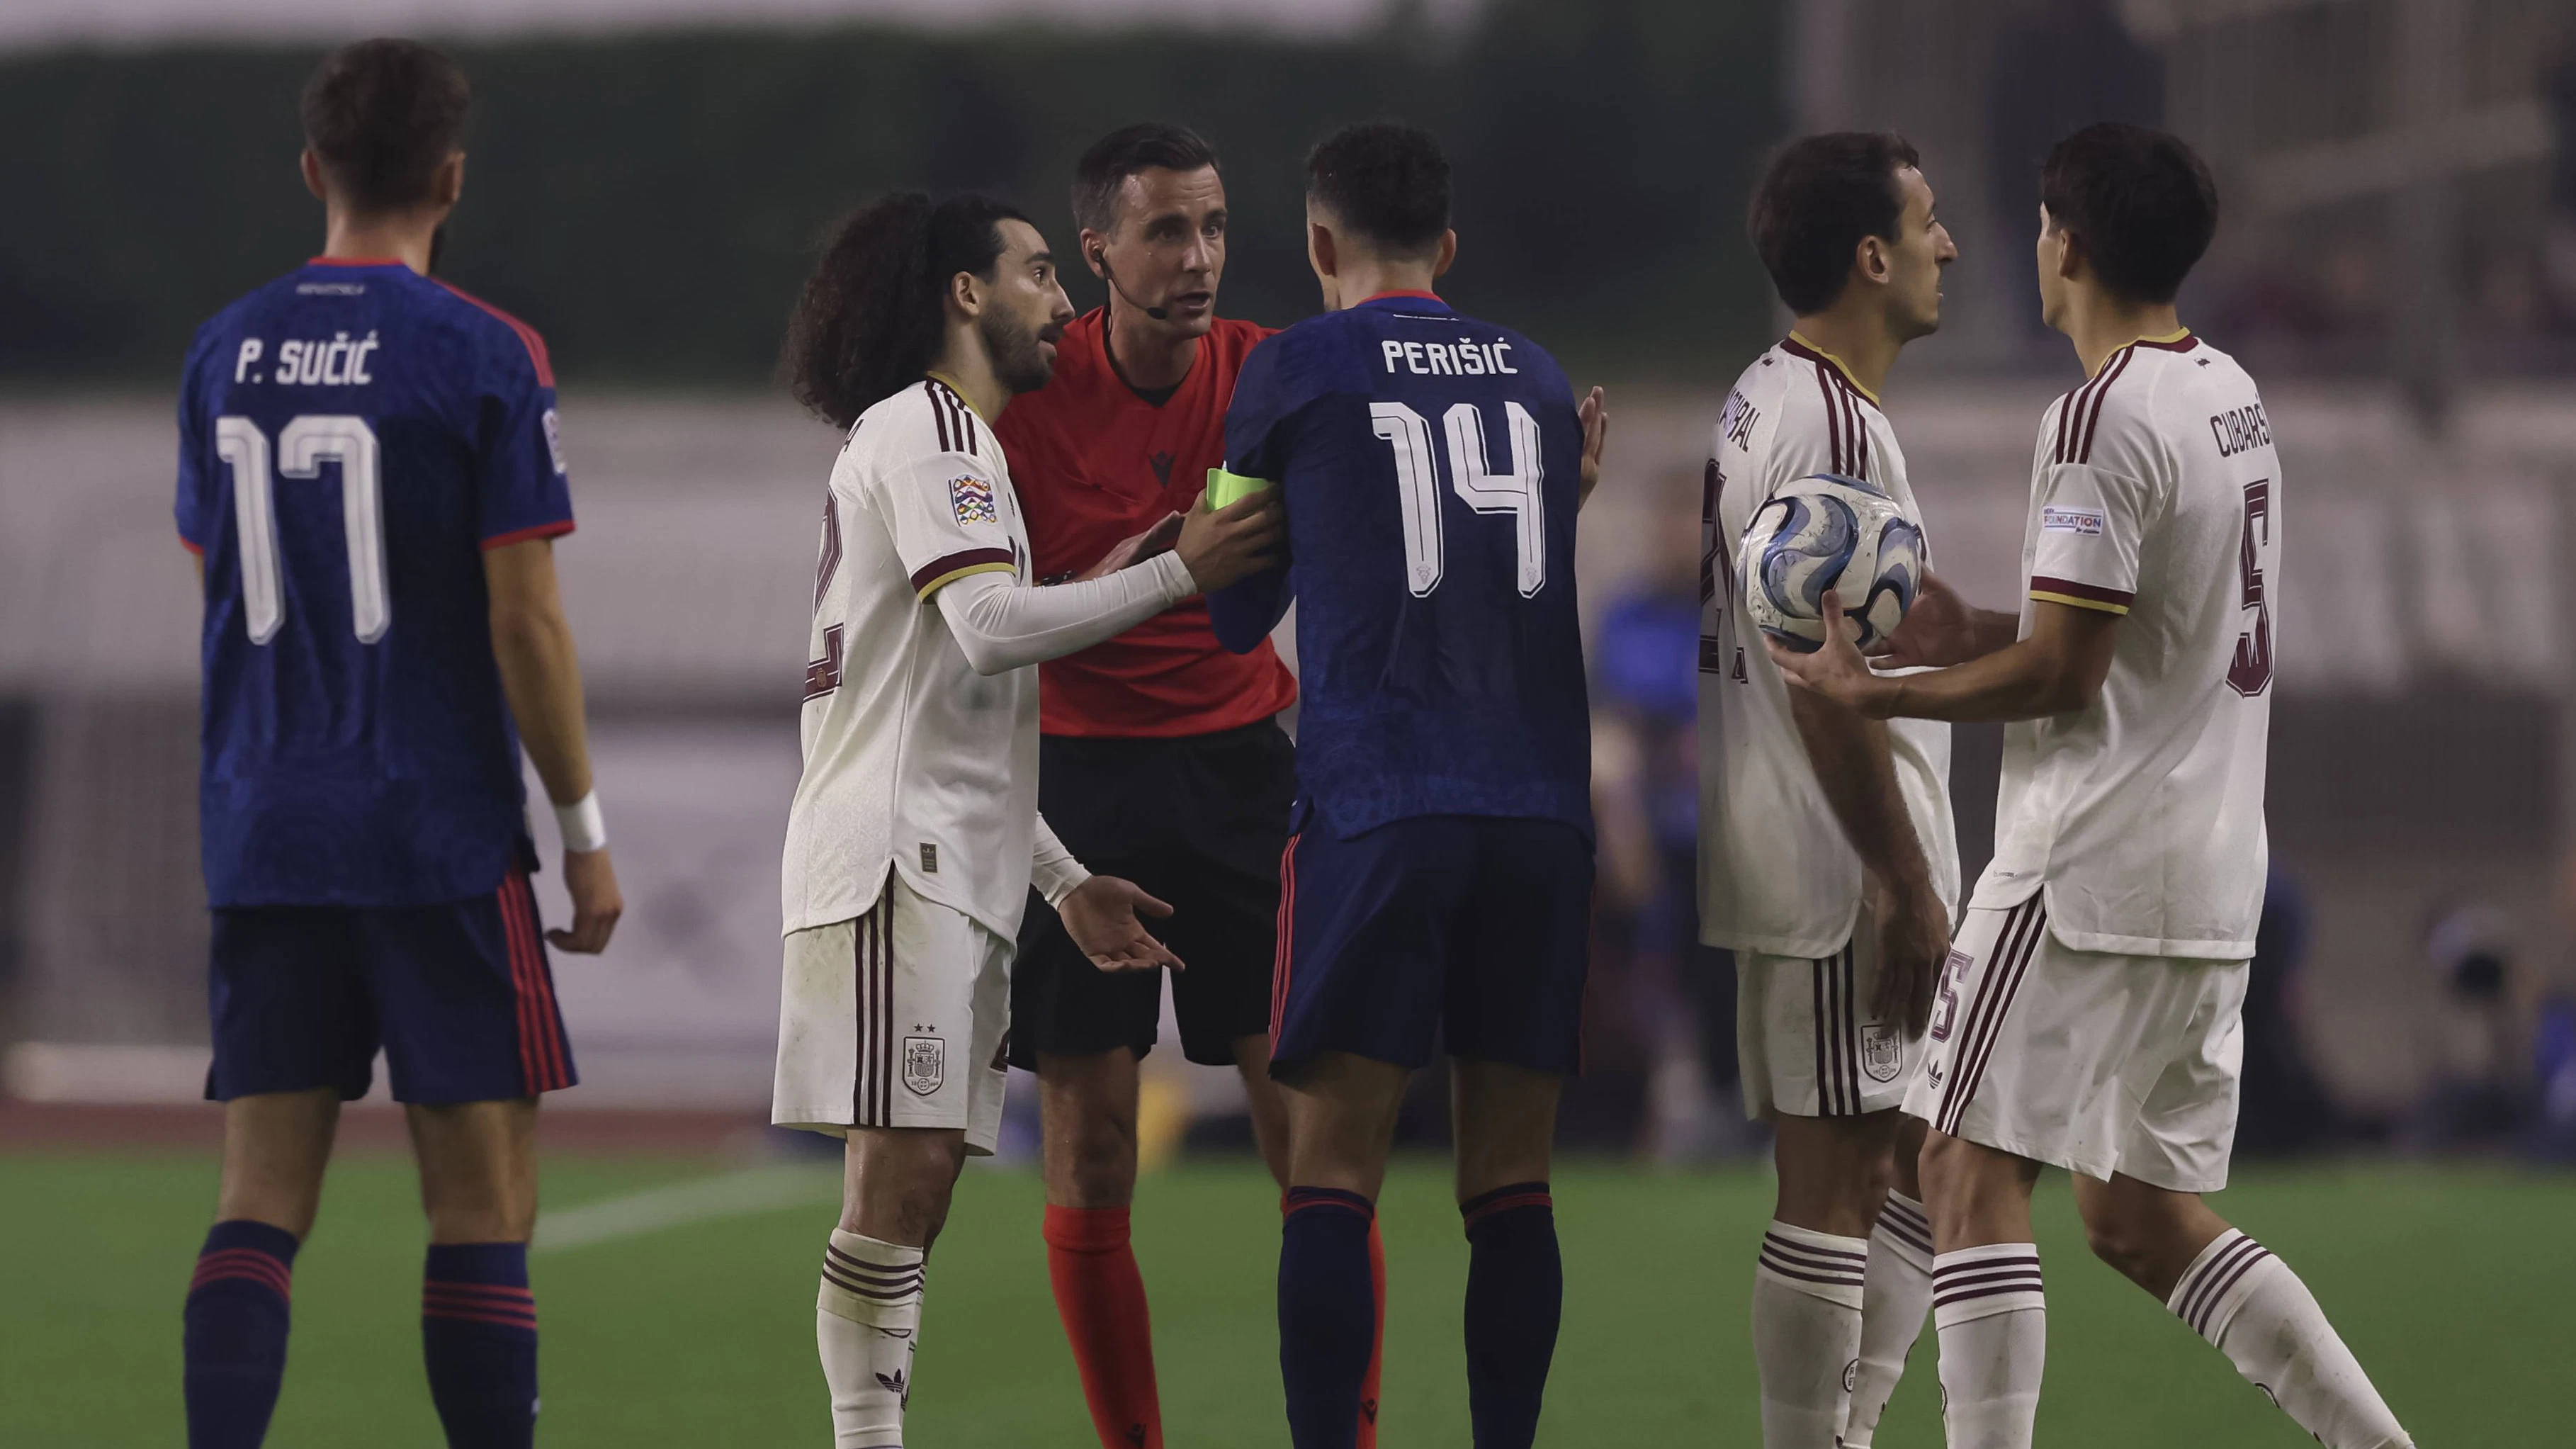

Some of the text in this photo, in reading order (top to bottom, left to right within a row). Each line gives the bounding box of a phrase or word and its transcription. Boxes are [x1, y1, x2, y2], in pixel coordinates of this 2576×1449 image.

[235, 330, 378, 385] P. SUČIĆ
[1382, 337, 1518, 375] PERIŠIĆ
[2210, 393, 2270, 458] CUBARS
[216, 415, 391, 645] 17
[1369, 401, 1546, 599] 14
[2226, 478, 2273, 699] 5
[1929, 949, 1975, 1043] 5
